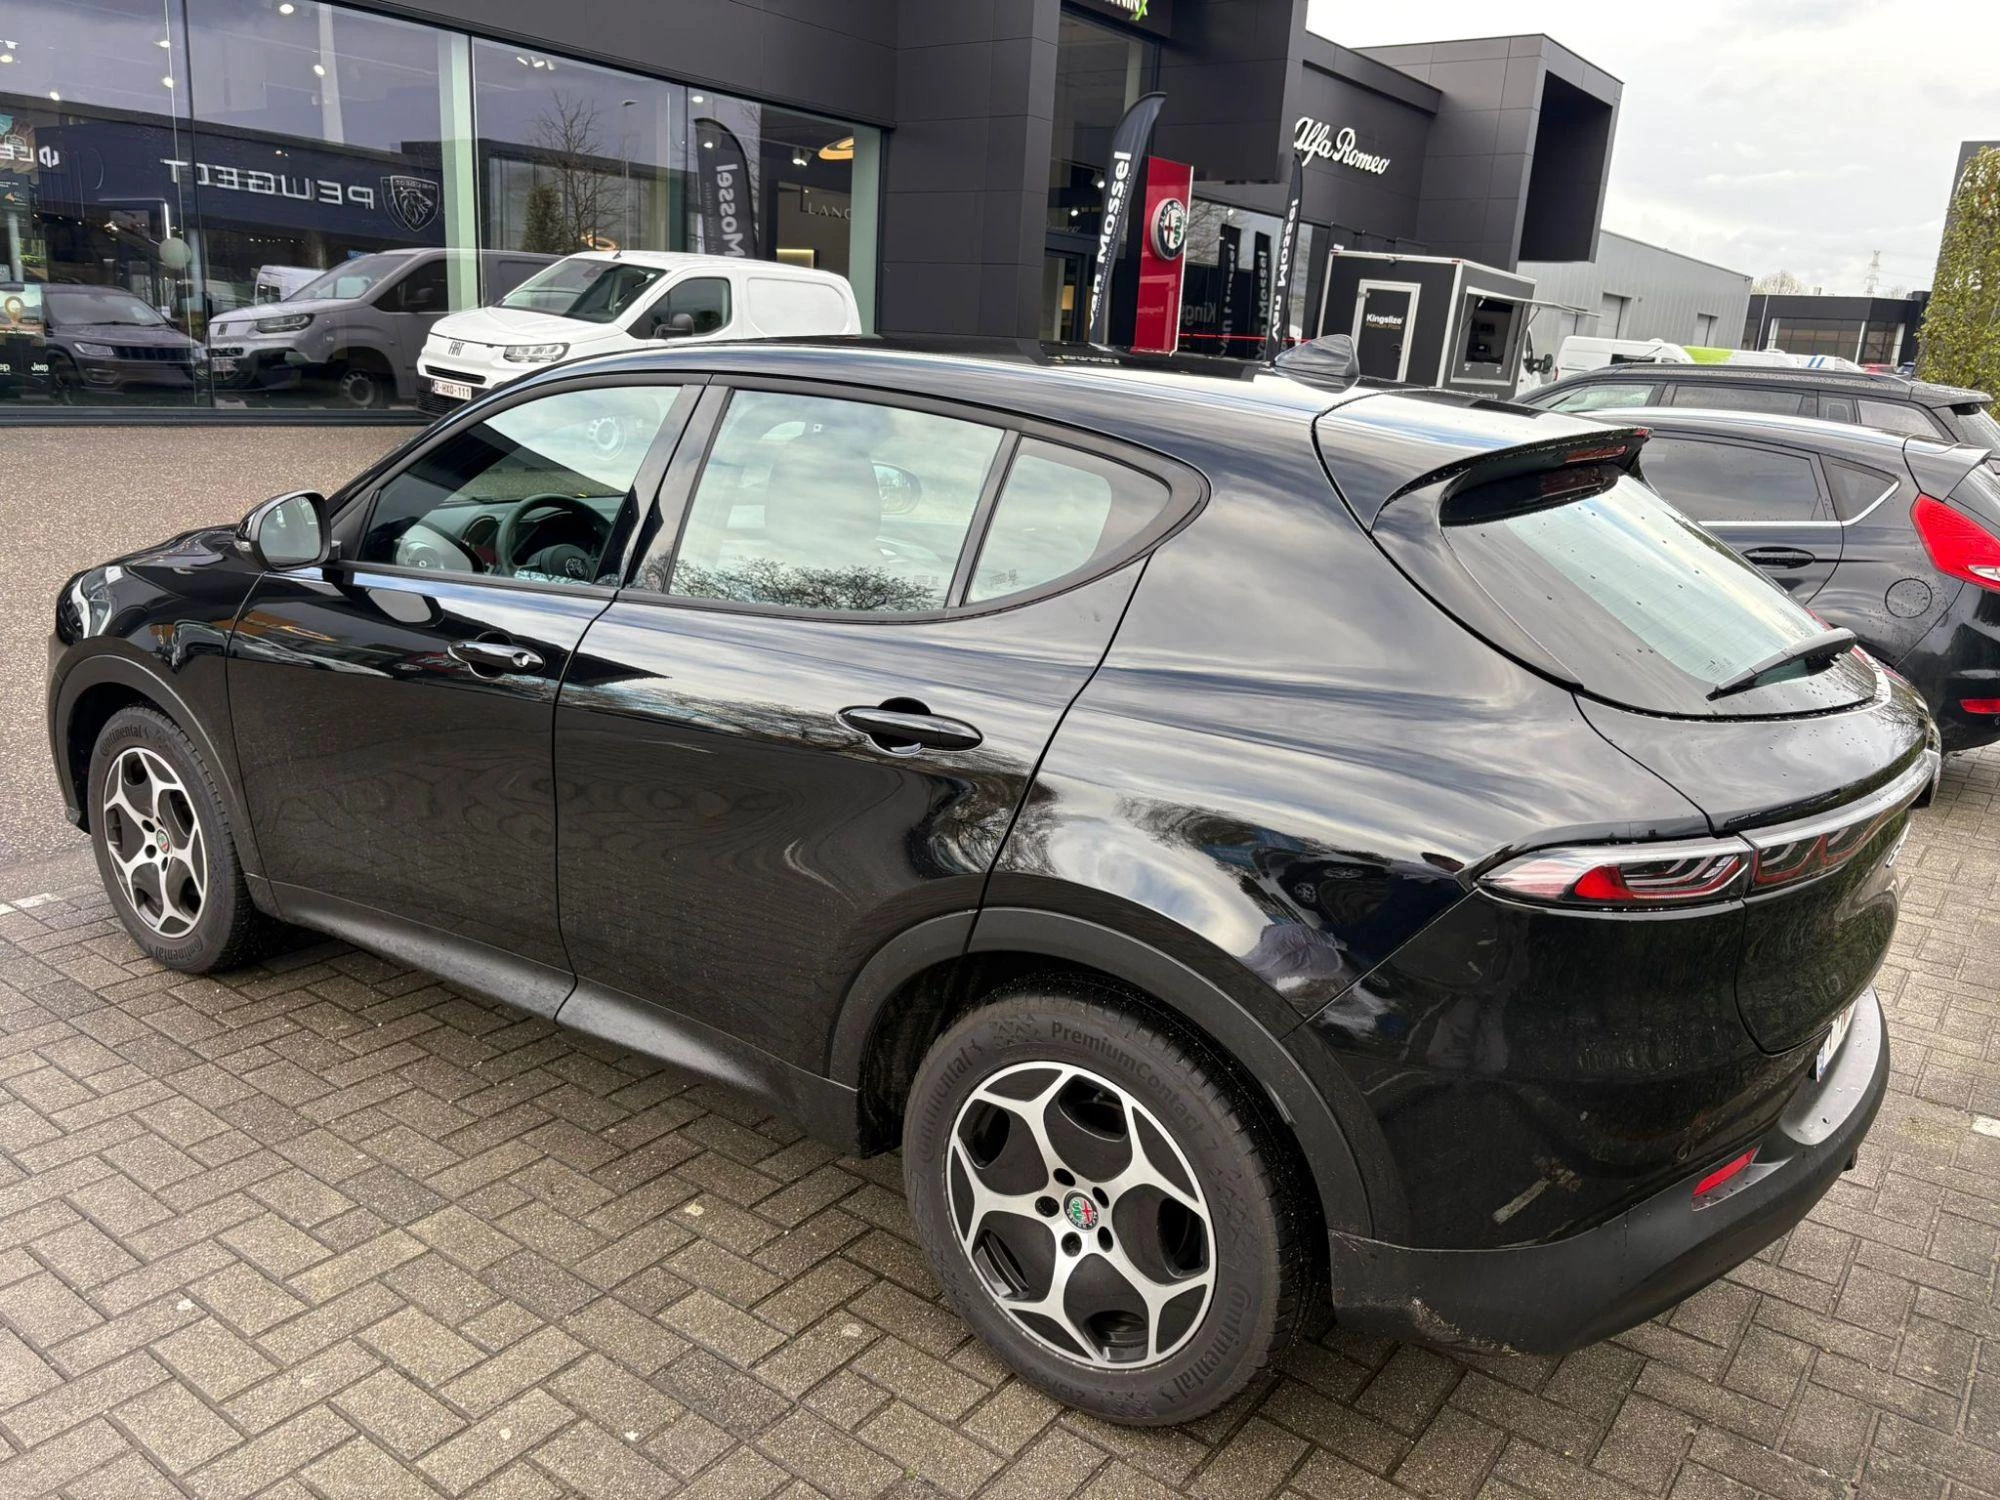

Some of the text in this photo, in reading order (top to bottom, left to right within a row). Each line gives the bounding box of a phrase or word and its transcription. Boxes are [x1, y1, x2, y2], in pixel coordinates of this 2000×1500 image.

[1294, 116, 1391, 175] Alfa Romeo
[1098, 150, 1132, 264] Mossel
[31, 361, 49, 372] Jeep
[447, 340, 465, 356] FIAT
